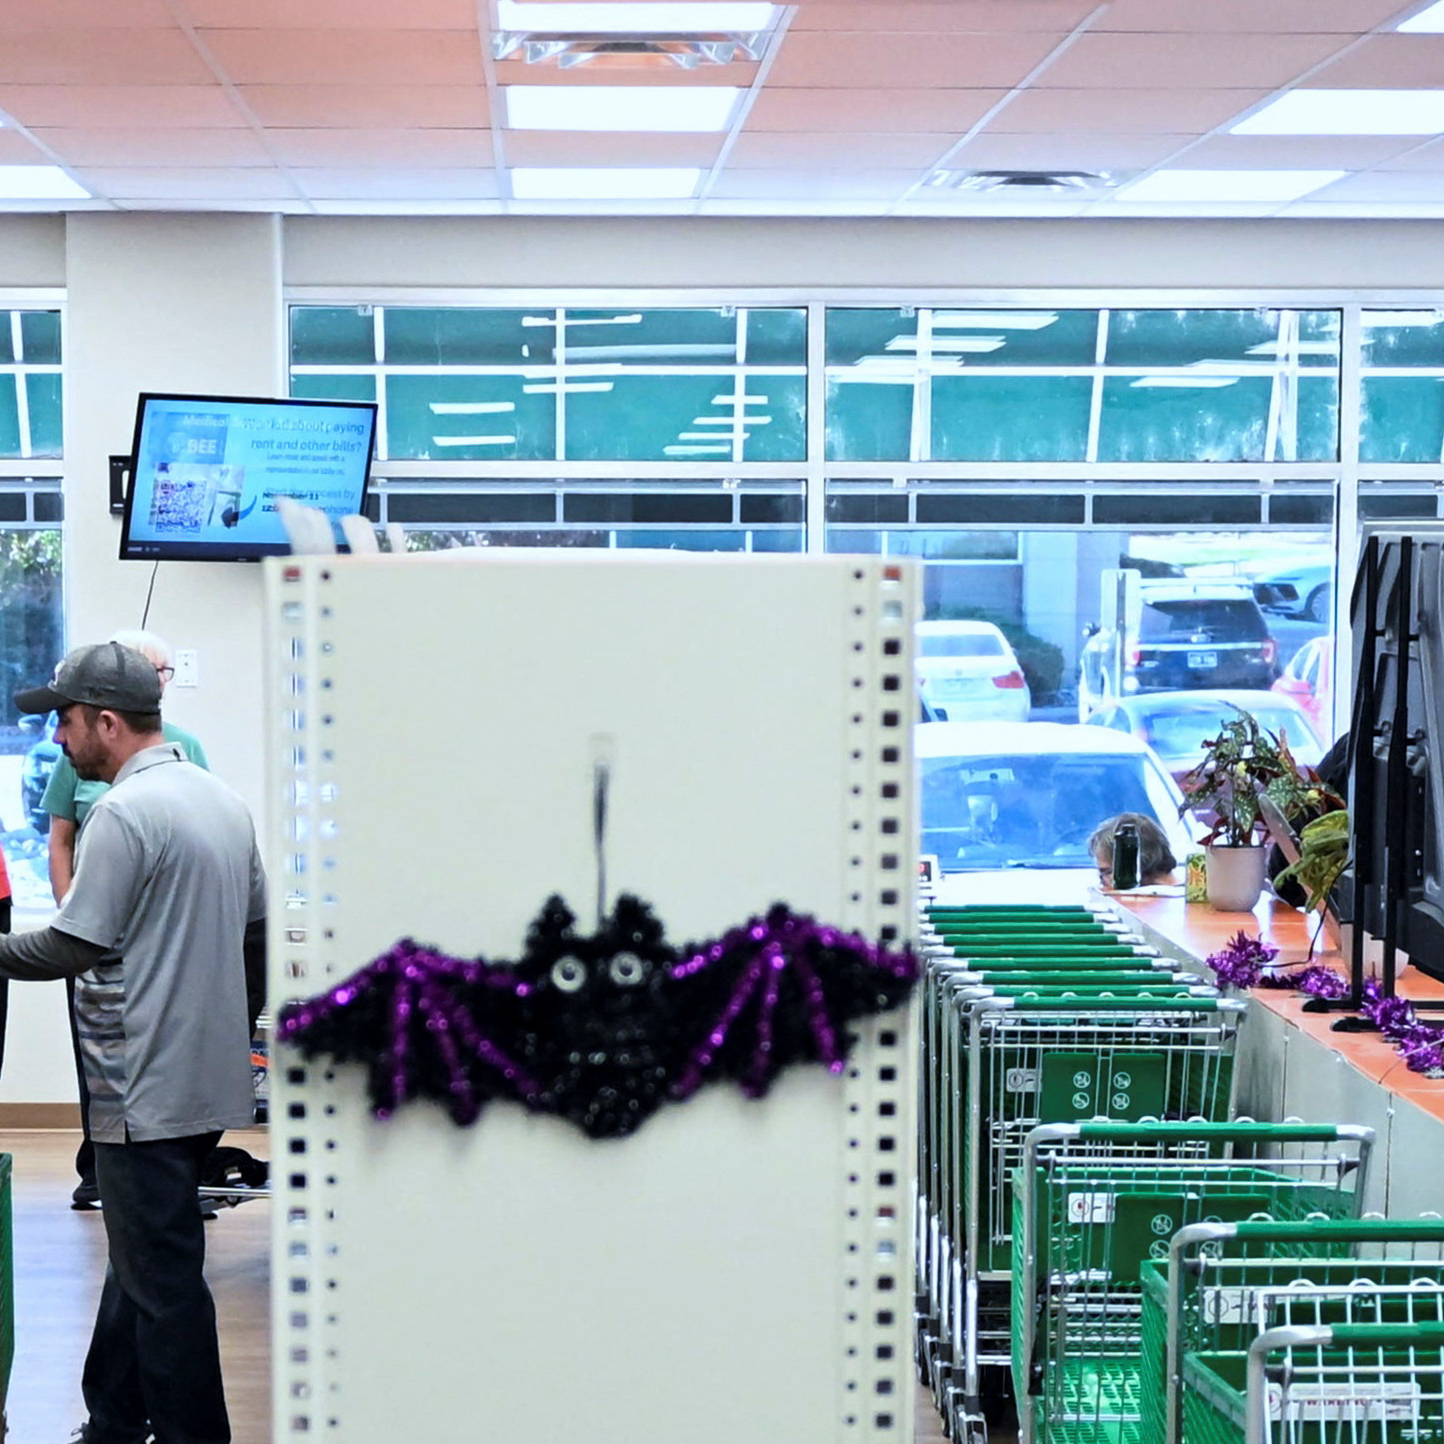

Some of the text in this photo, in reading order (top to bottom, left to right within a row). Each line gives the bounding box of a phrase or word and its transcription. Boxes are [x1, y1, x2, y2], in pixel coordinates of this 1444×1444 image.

[325, 422, 364, 436] paying
[251, 439, 362, 453] rent and other bills?
